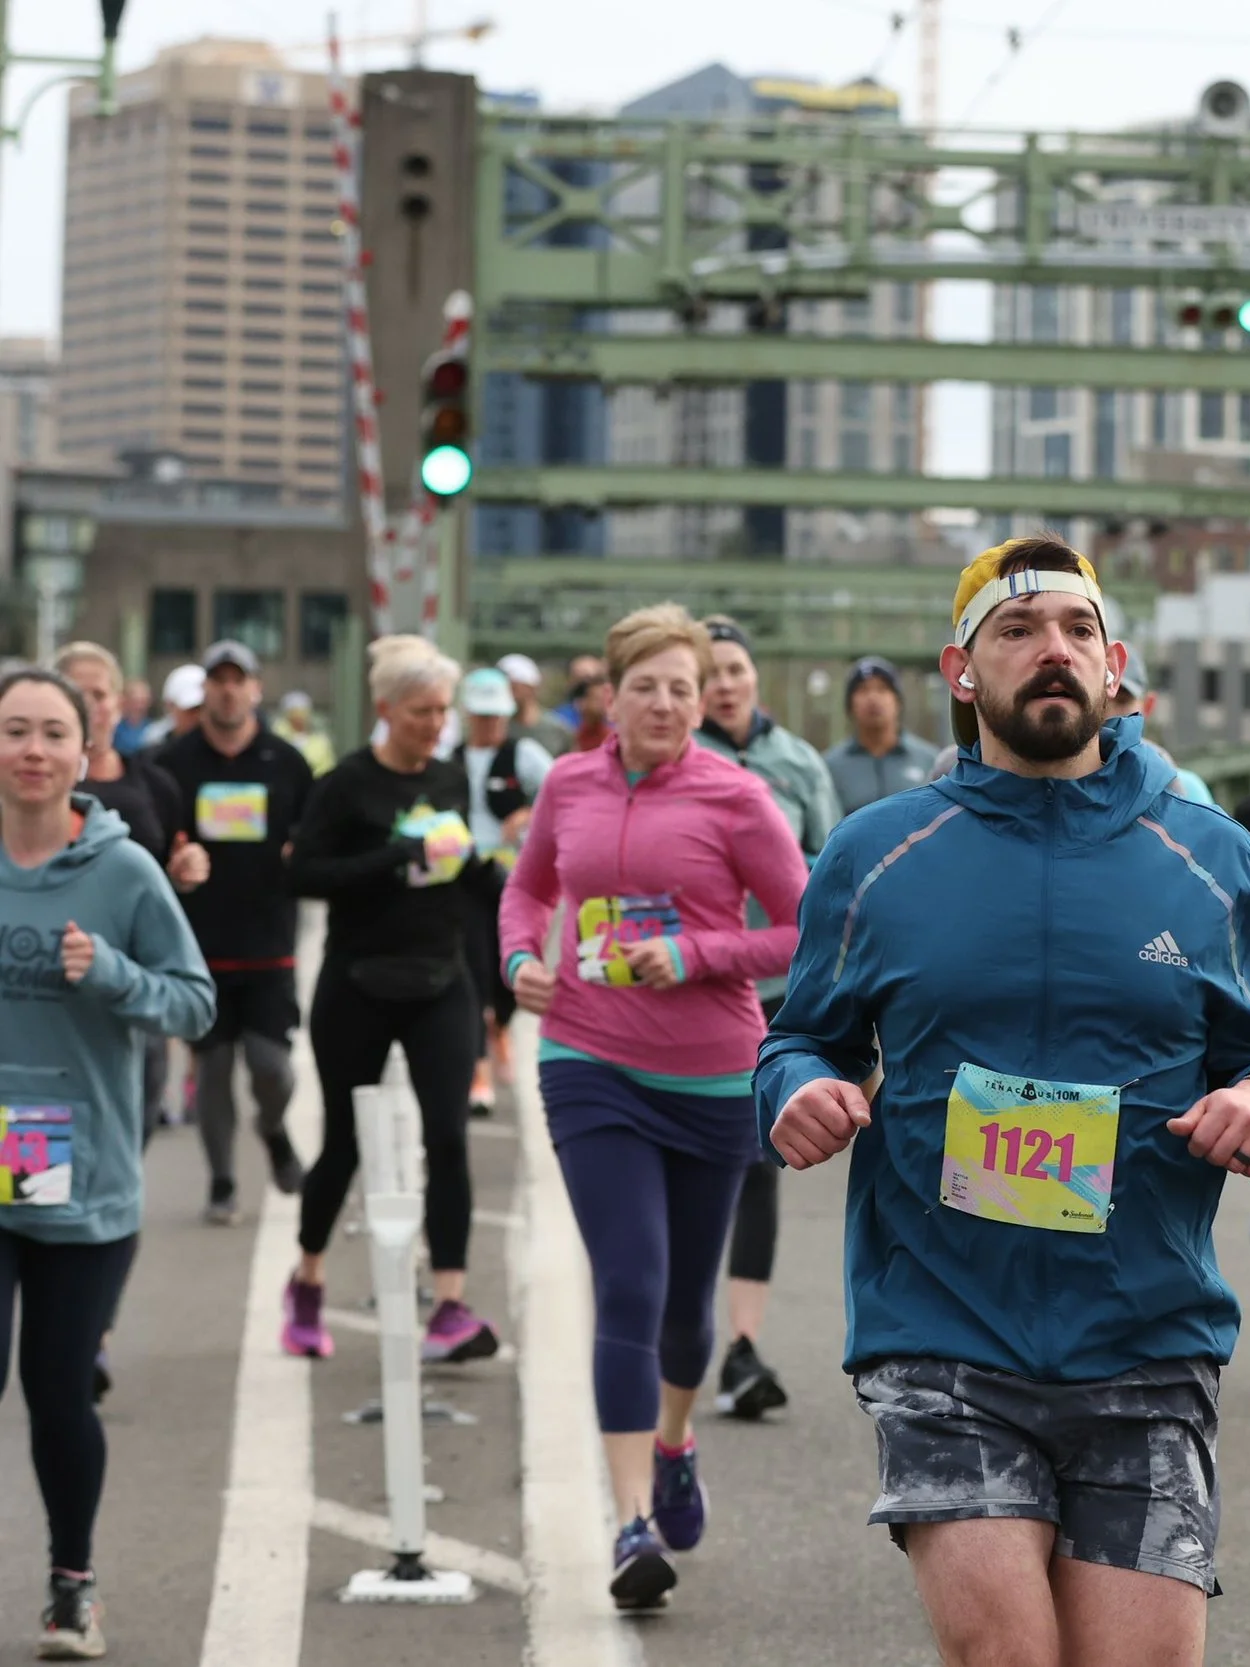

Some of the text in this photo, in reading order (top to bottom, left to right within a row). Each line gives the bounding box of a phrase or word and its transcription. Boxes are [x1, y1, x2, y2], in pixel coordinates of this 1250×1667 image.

[1138, 949, 1188, 967] adidas
[1055, 1089, 1080, 1101] 10M
[979, 1122, 1075, 1183] 1121
